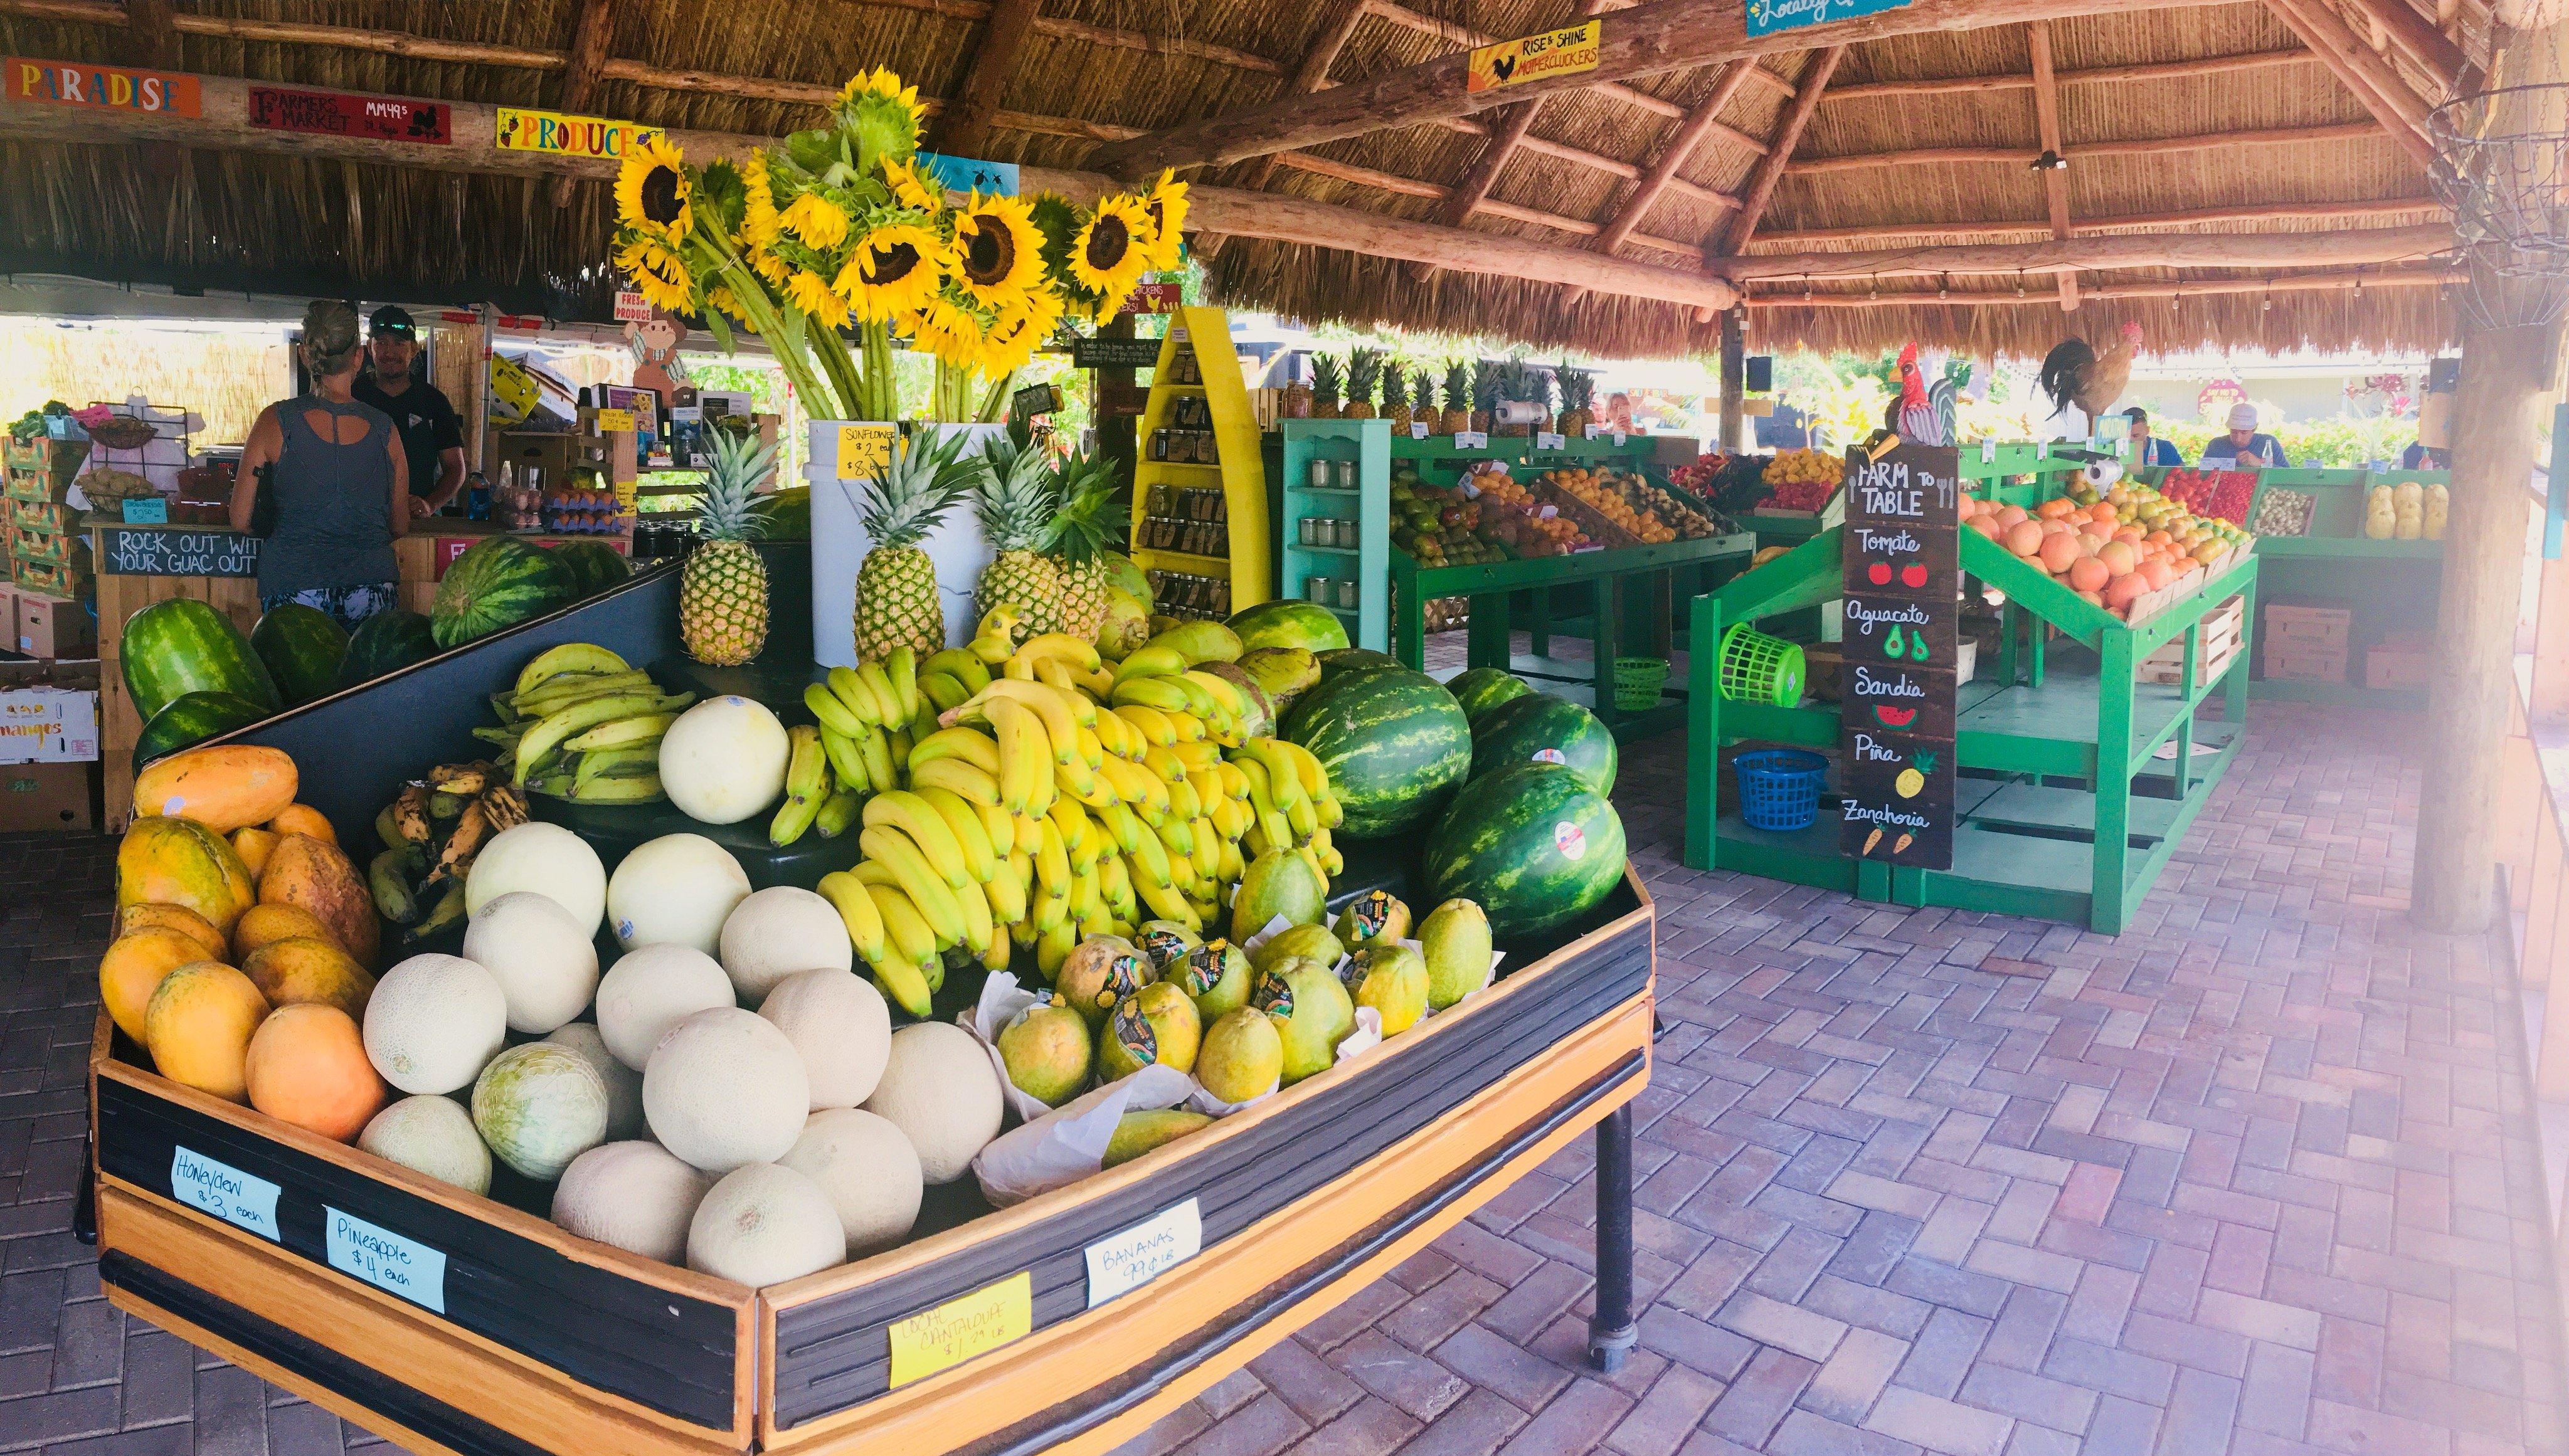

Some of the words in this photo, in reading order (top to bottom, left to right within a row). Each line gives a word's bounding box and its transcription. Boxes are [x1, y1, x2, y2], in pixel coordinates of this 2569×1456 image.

[1522, 40, 1546, 56] RISE
[1547, 35, 1554, 45] &
[1557, 28, 1587, 48] SHINE
[1517, 48, 1597, 76] MOTHERCLUCKERS
[19, 63, 179, 112] PARADISE
[253, 90, 338, 125] FARMERS
[282, 109, 351, 132] MARKET
[521, 115, 634, 158] PRODUCE
[622, 294, 645, 306] FRESH
[1135, 285, 1163, 295] HICKENS
[616, 307, 650, 320] PRODUCE
[1858, 462, 1909, 490] FARM
[1860, 487, 1924, 517] TABLE
[118, 531, 173, 555] ROCK
[179, 534, 221, 555] OUT
[228, 537, 264, 555] WIT
[1854, 529, 1921, 556] Tomate
[111, 551, 162, 573] YOUR
[167, 554, 214, 574] GUAC
[218, 555, 257, 574] OUT
[1855, 666, 1925, 698] Sandia
[1855, 734, 1902, 762] Piña
[1841, 799, 1931, 828] Zanahoria
[236, 1205, 265, 1224] each
[1102, 1227, 1175, 1271] BANANAS
[384, 1267, 410, 1287] each
